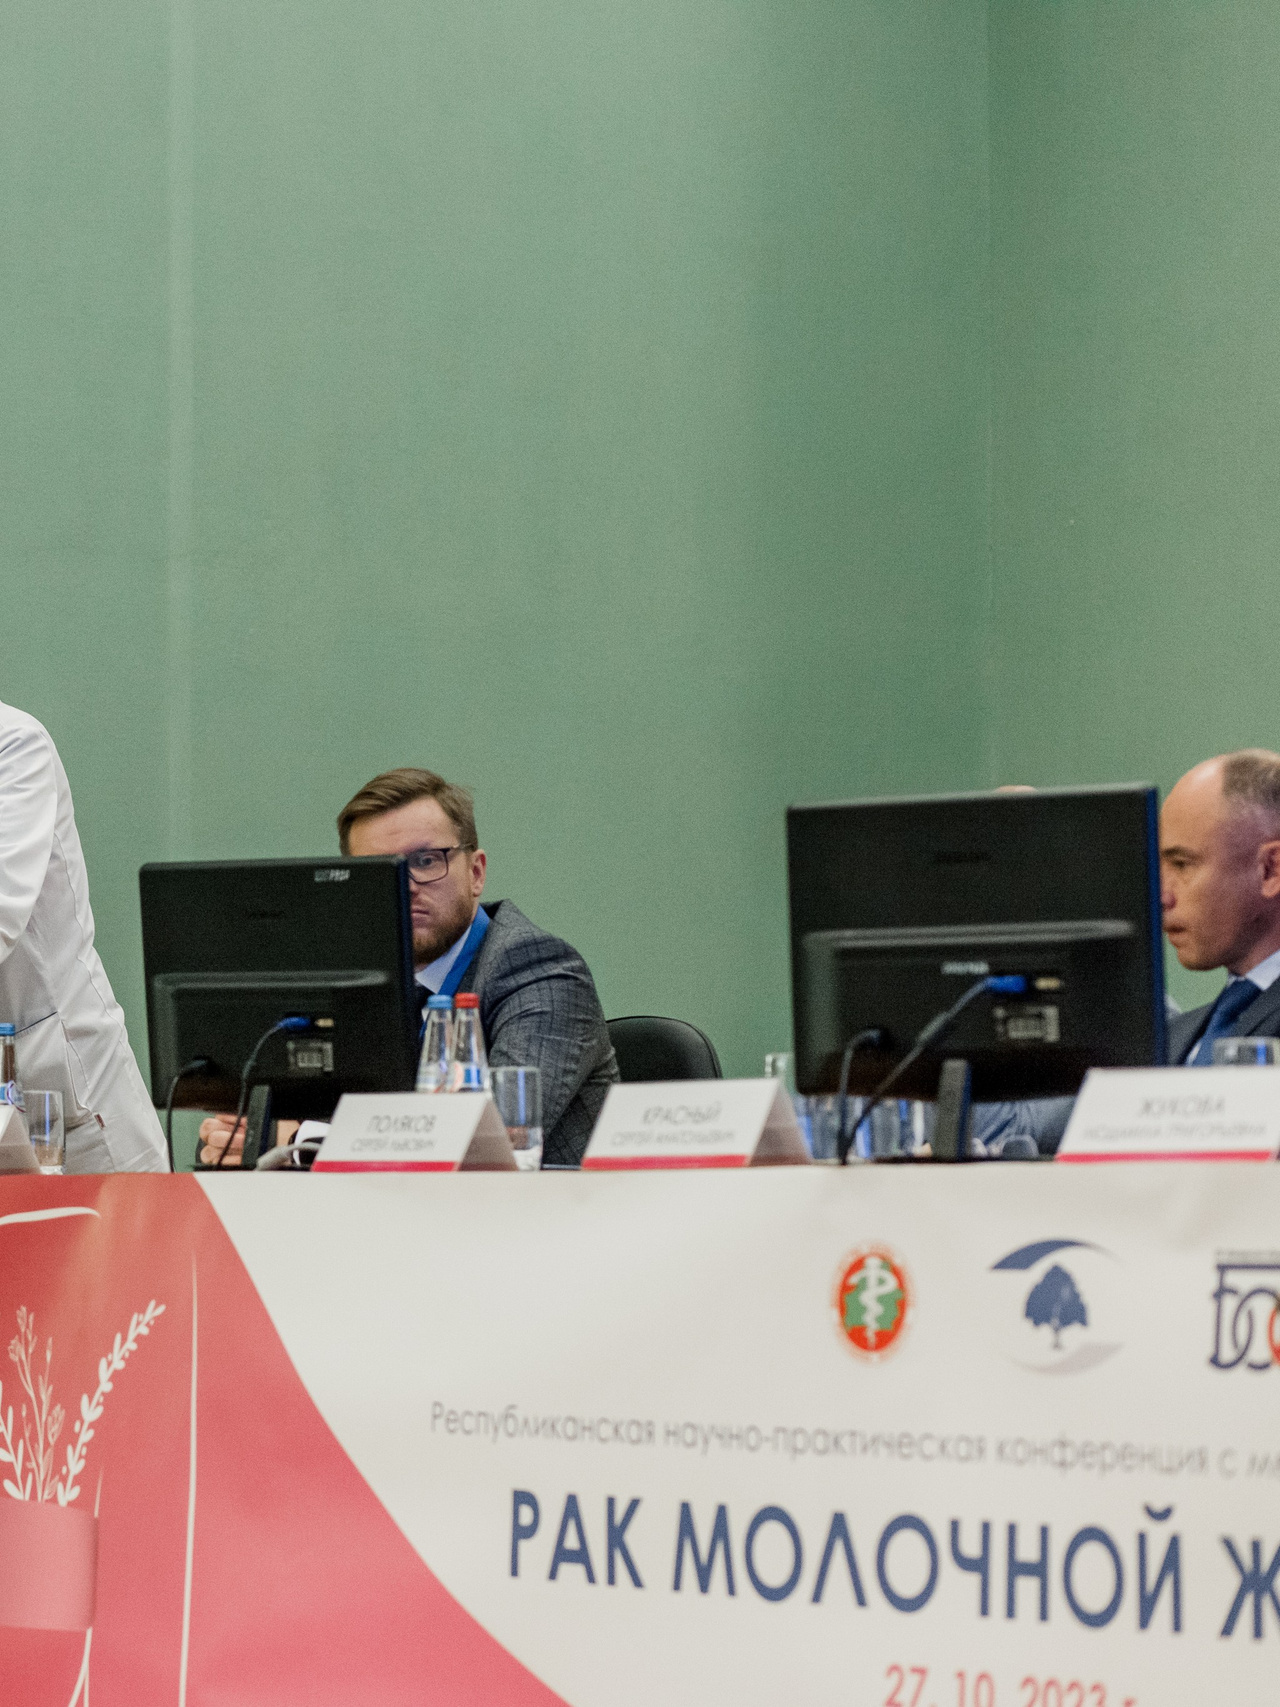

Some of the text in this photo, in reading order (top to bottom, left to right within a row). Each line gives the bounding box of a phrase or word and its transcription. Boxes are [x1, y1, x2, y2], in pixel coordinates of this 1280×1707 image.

[431, 1401, 656, 1444] Республиканская
[663, 1421, 987, 1463] научно-практическая
[996, 1432, 1211, 1478] конференция
[1220, 1446, 1238, 1478] с
[509, 1488, 645, 1589] РАК
[672, 1501, 1184, 1633] МОЛОЧНОЙ
